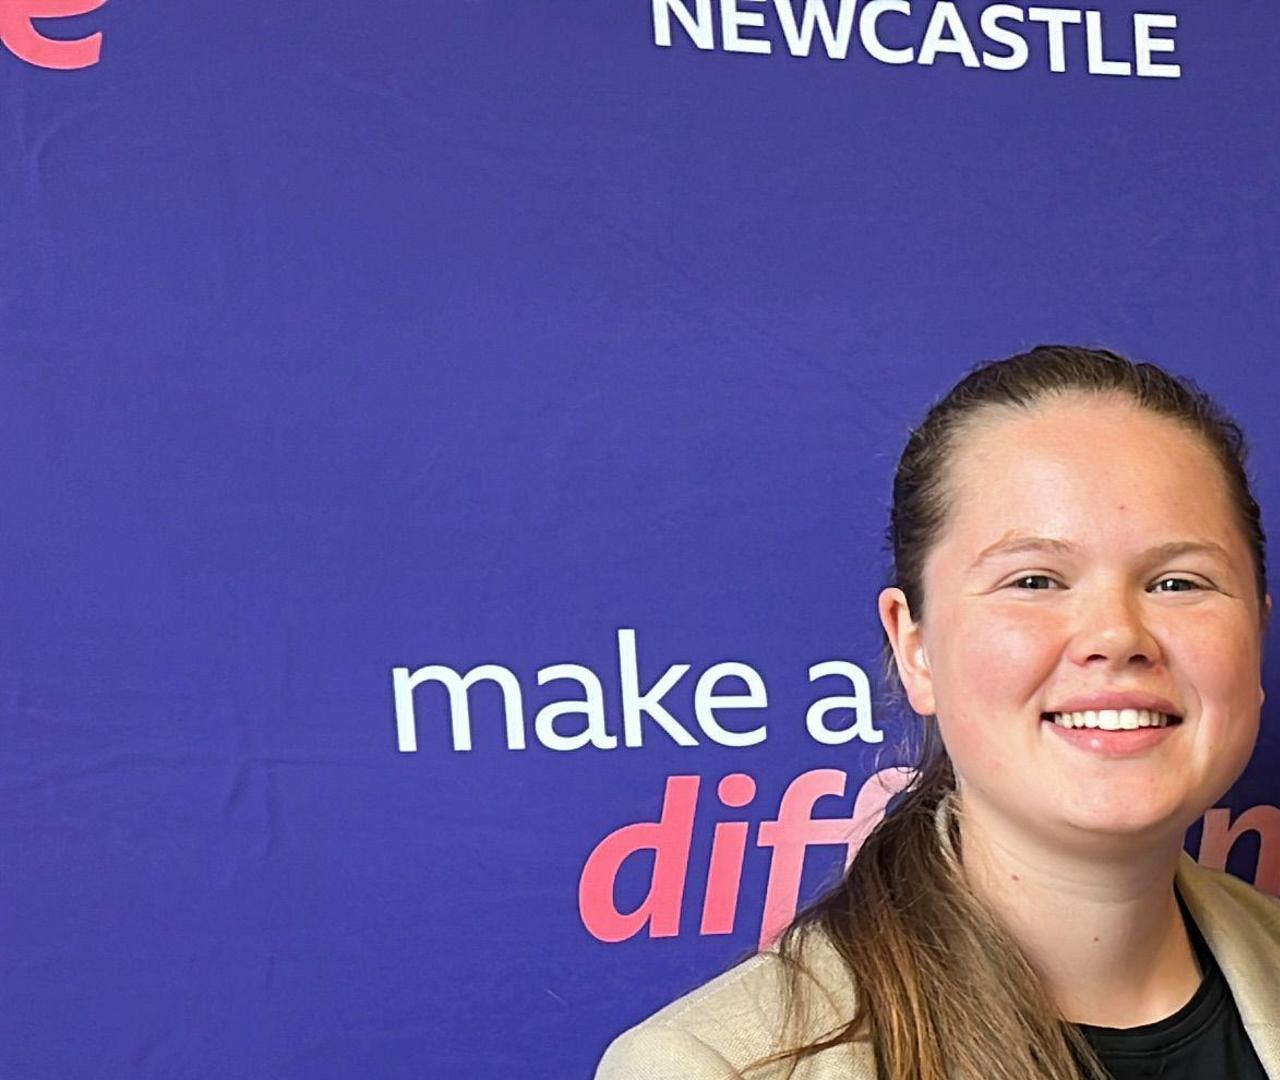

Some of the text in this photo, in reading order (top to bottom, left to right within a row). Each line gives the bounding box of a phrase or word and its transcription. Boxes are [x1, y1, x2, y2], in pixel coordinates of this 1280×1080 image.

[652, 0, 1181, 78] NEWCASTLE
[392, 628, 883, 752] make a
